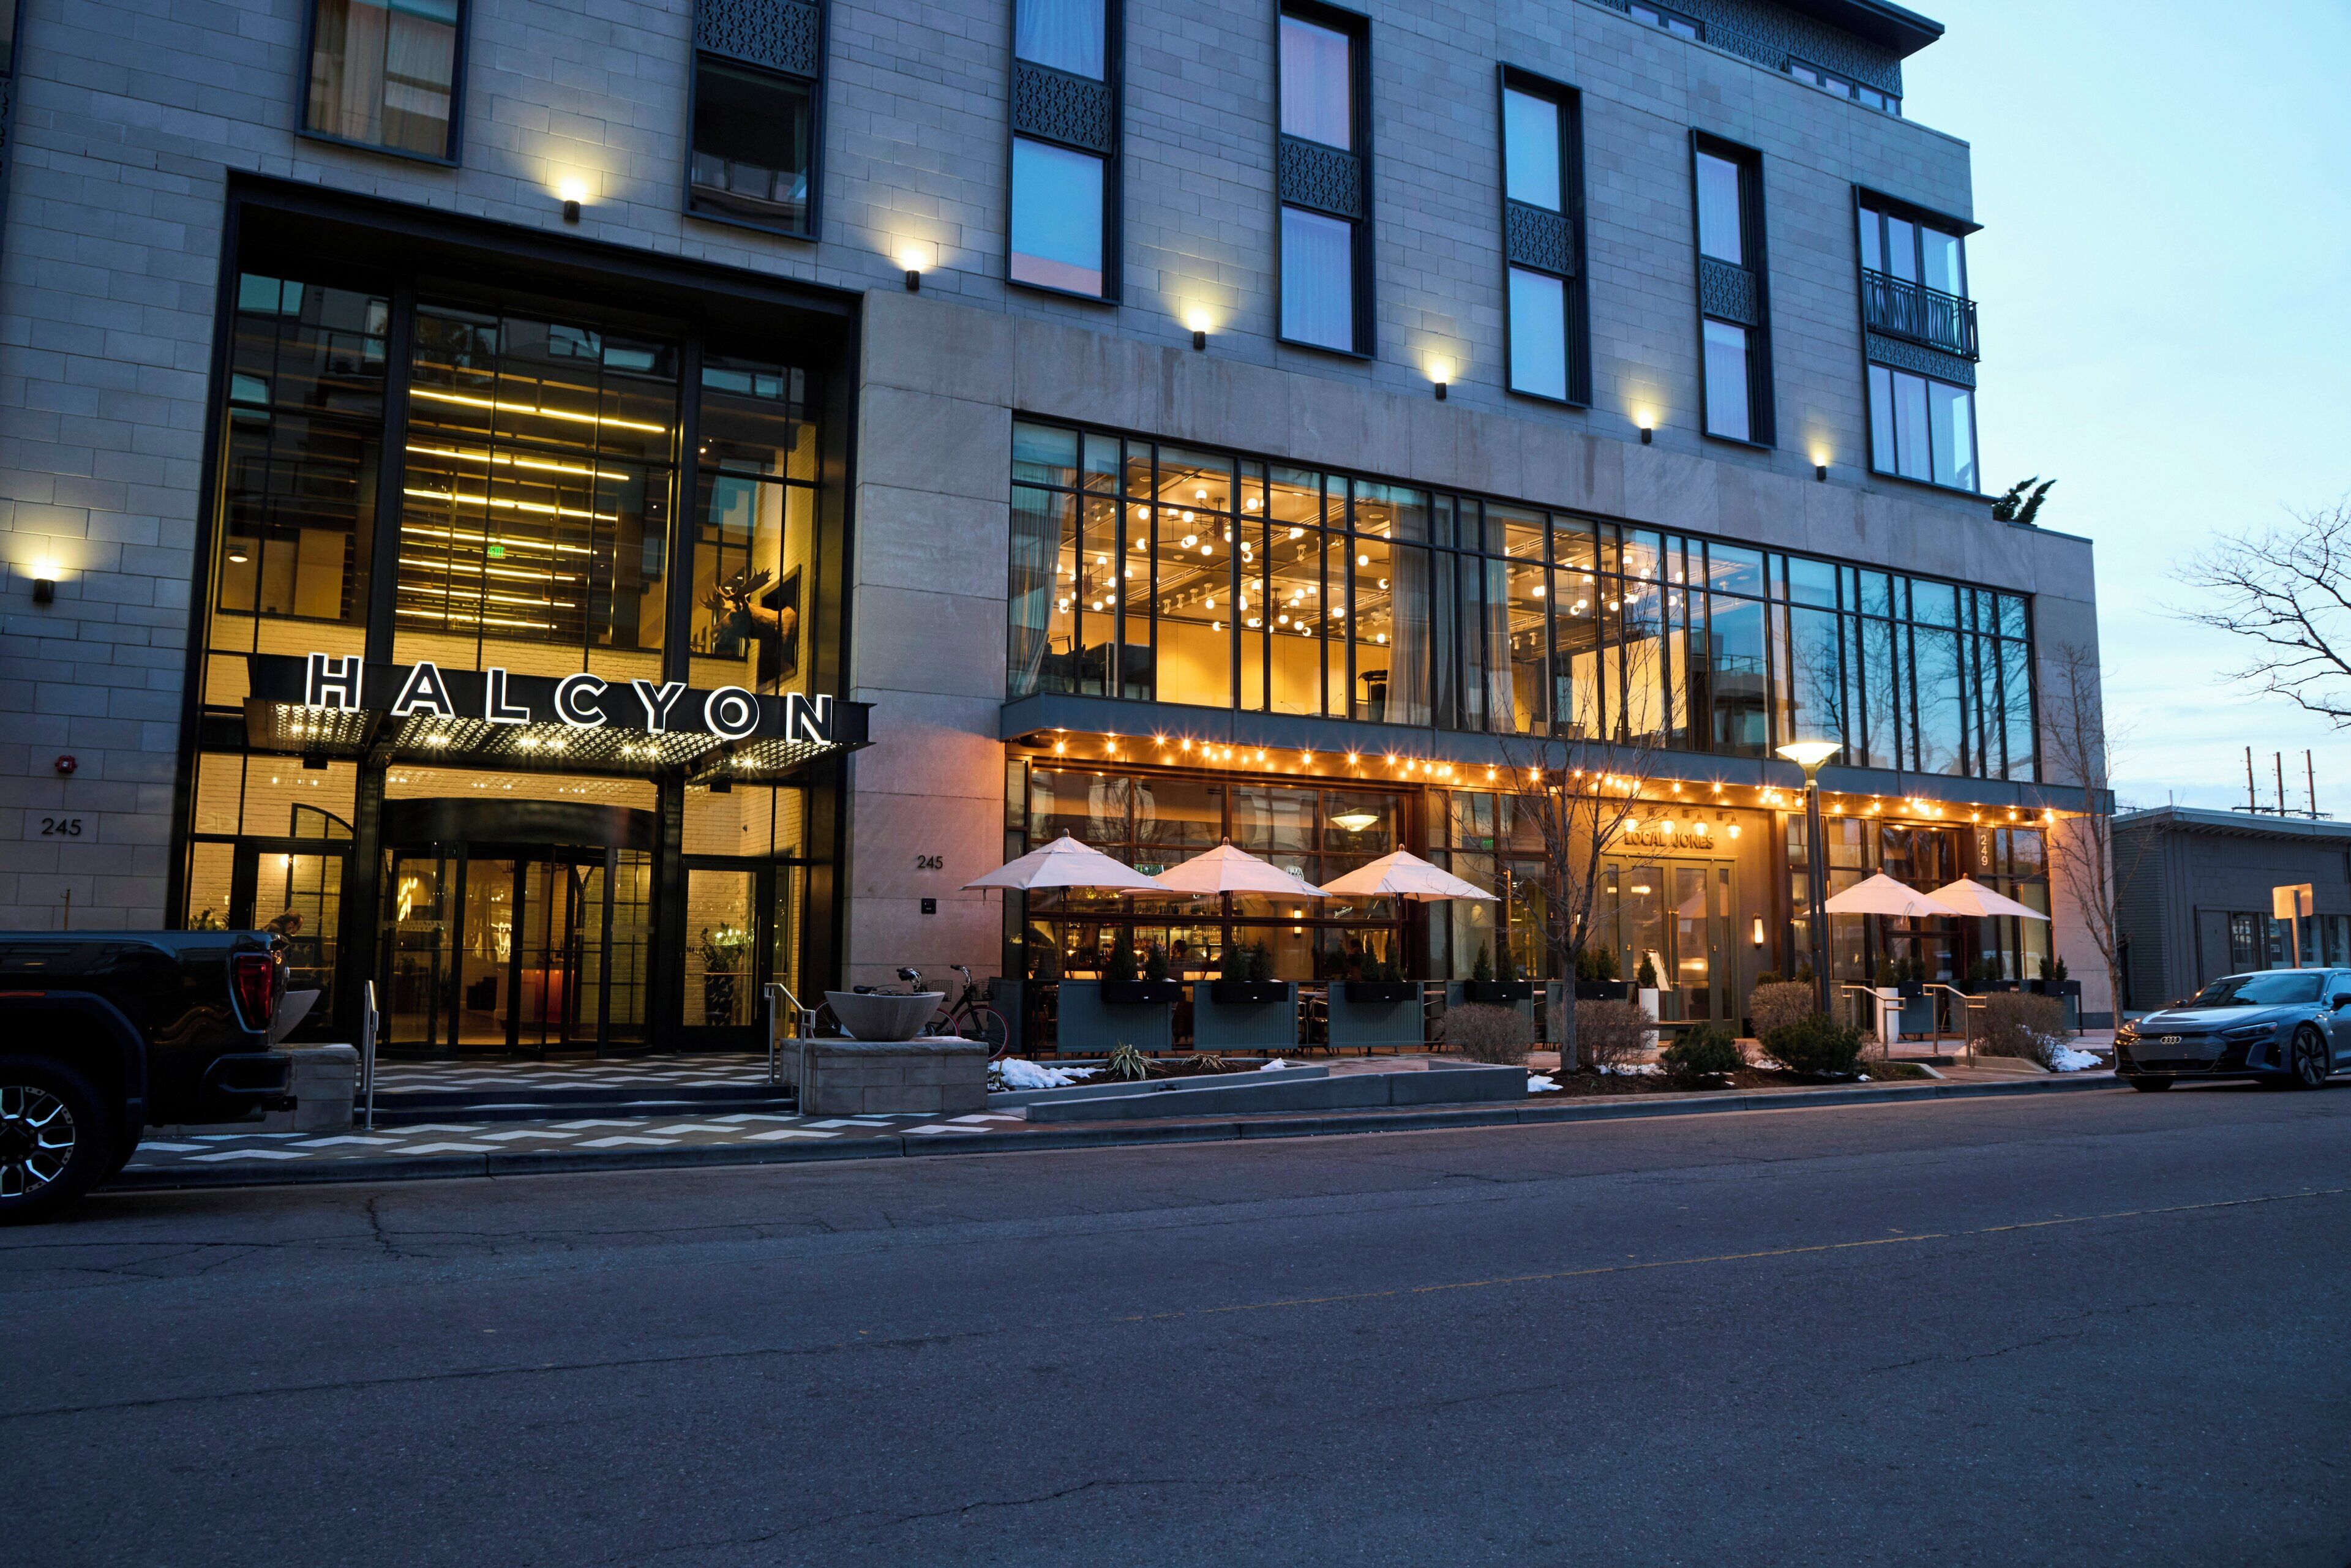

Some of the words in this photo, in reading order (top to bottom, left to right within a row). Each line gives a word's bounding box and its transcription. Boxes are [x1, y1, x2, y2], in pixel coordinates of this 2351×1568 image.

[306, 652, 833, 745] HALCYON
[42, 817, 82, 836] 245
[1624, 830, 1666, 847] LOCAL
[1673, 833, 1714, 849] JONES
[918, 855, 943, 869] 245
